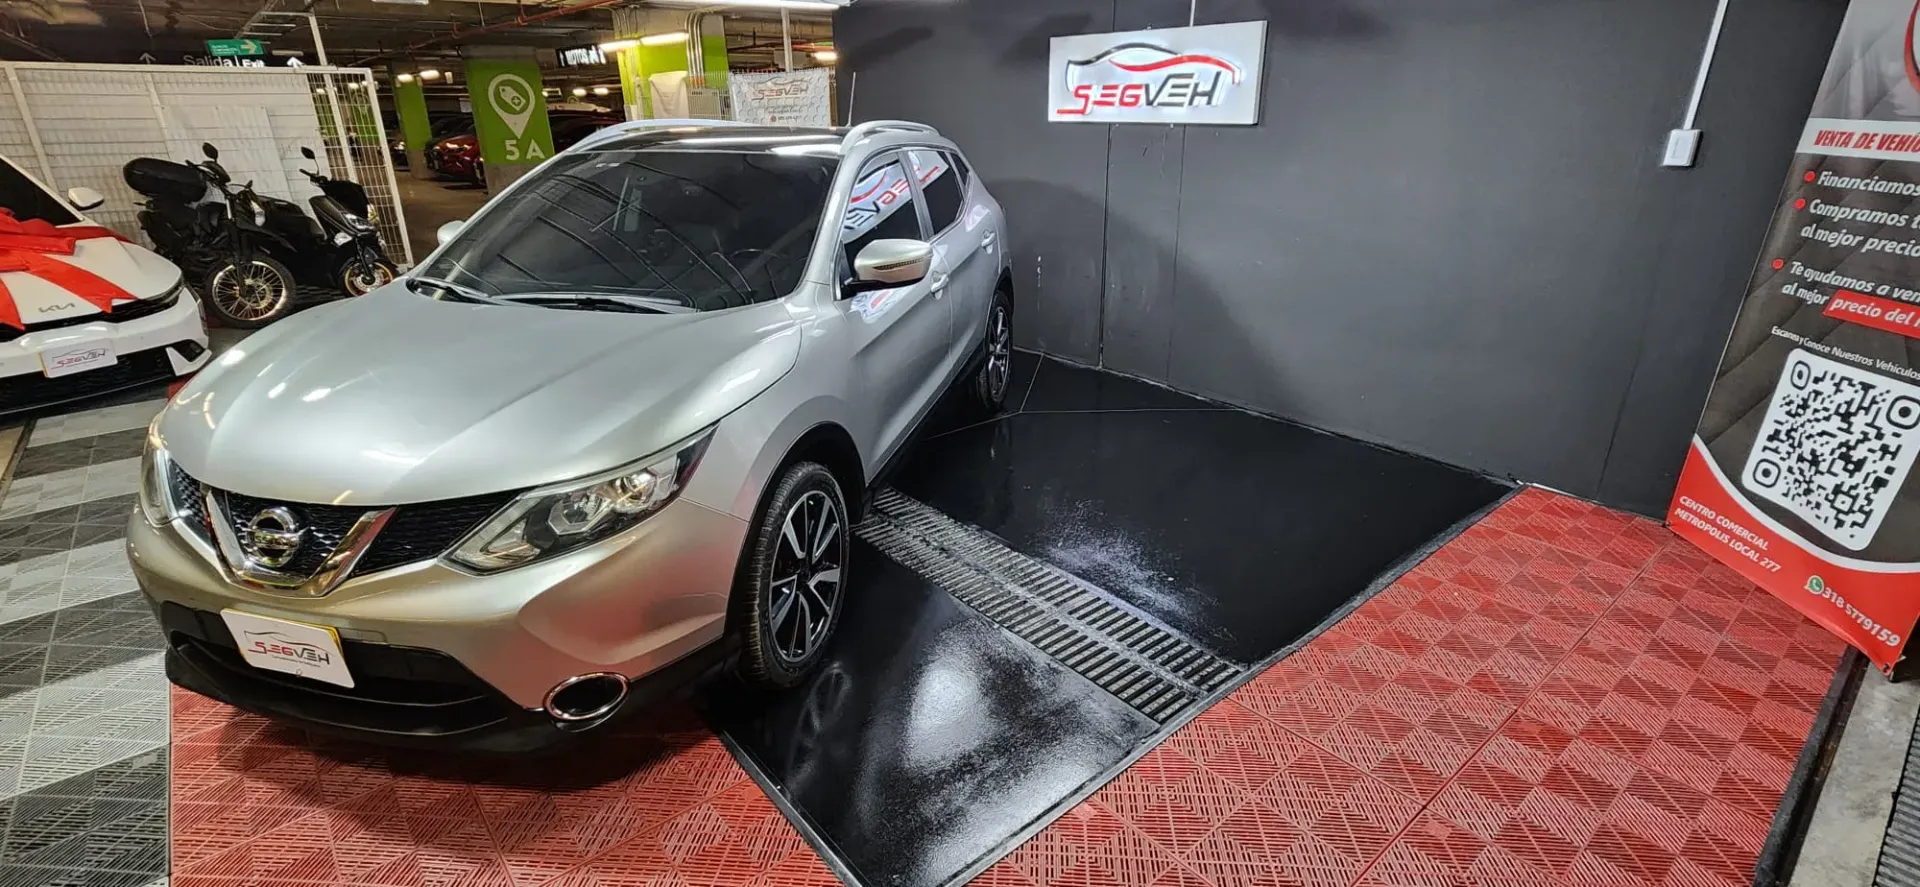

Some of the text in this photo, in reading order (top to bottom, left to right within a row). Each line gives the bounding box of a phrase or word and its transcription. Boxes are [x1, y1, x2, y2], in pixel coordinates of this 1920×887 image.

[183, 54, 234, 67] Salida
[1057, 71, 1221, 115] SEGVEH
[505, 139, 546, 160] 5 A
[1814, 129, 1855, 149] VENTA
[1852, 132, 1879, 150] DE
[1817, 170, 1920, 197] Financiamos
[1809, 198, 1909, 227] Compramos
[1800, 223, 1920, 257] al mejor precio
[1790, 261, 1804, 276] Te
[1803, 267, 1875, 293] ayudamos
[1876, 284, 1891, 296] a
[1781, 282, 1798, 296] al
[1796, 288, 1830, 305] mejor
[1829, 298, 1882, 318] precio
[1884, 308, 1915, 326] del
[1803, 337, 1831, 354] Conoce
[1831, 346, 1874, 367] Nuestros
[1679, 495, 1769, 550] CENTRO COMERCIAL
[1674, 507, 1782, 573] METROPOLIS LOCAL 277
[1821, 586, 1901, 647] 318 5779159
[247, 641, 330, 665] SEGVEH
